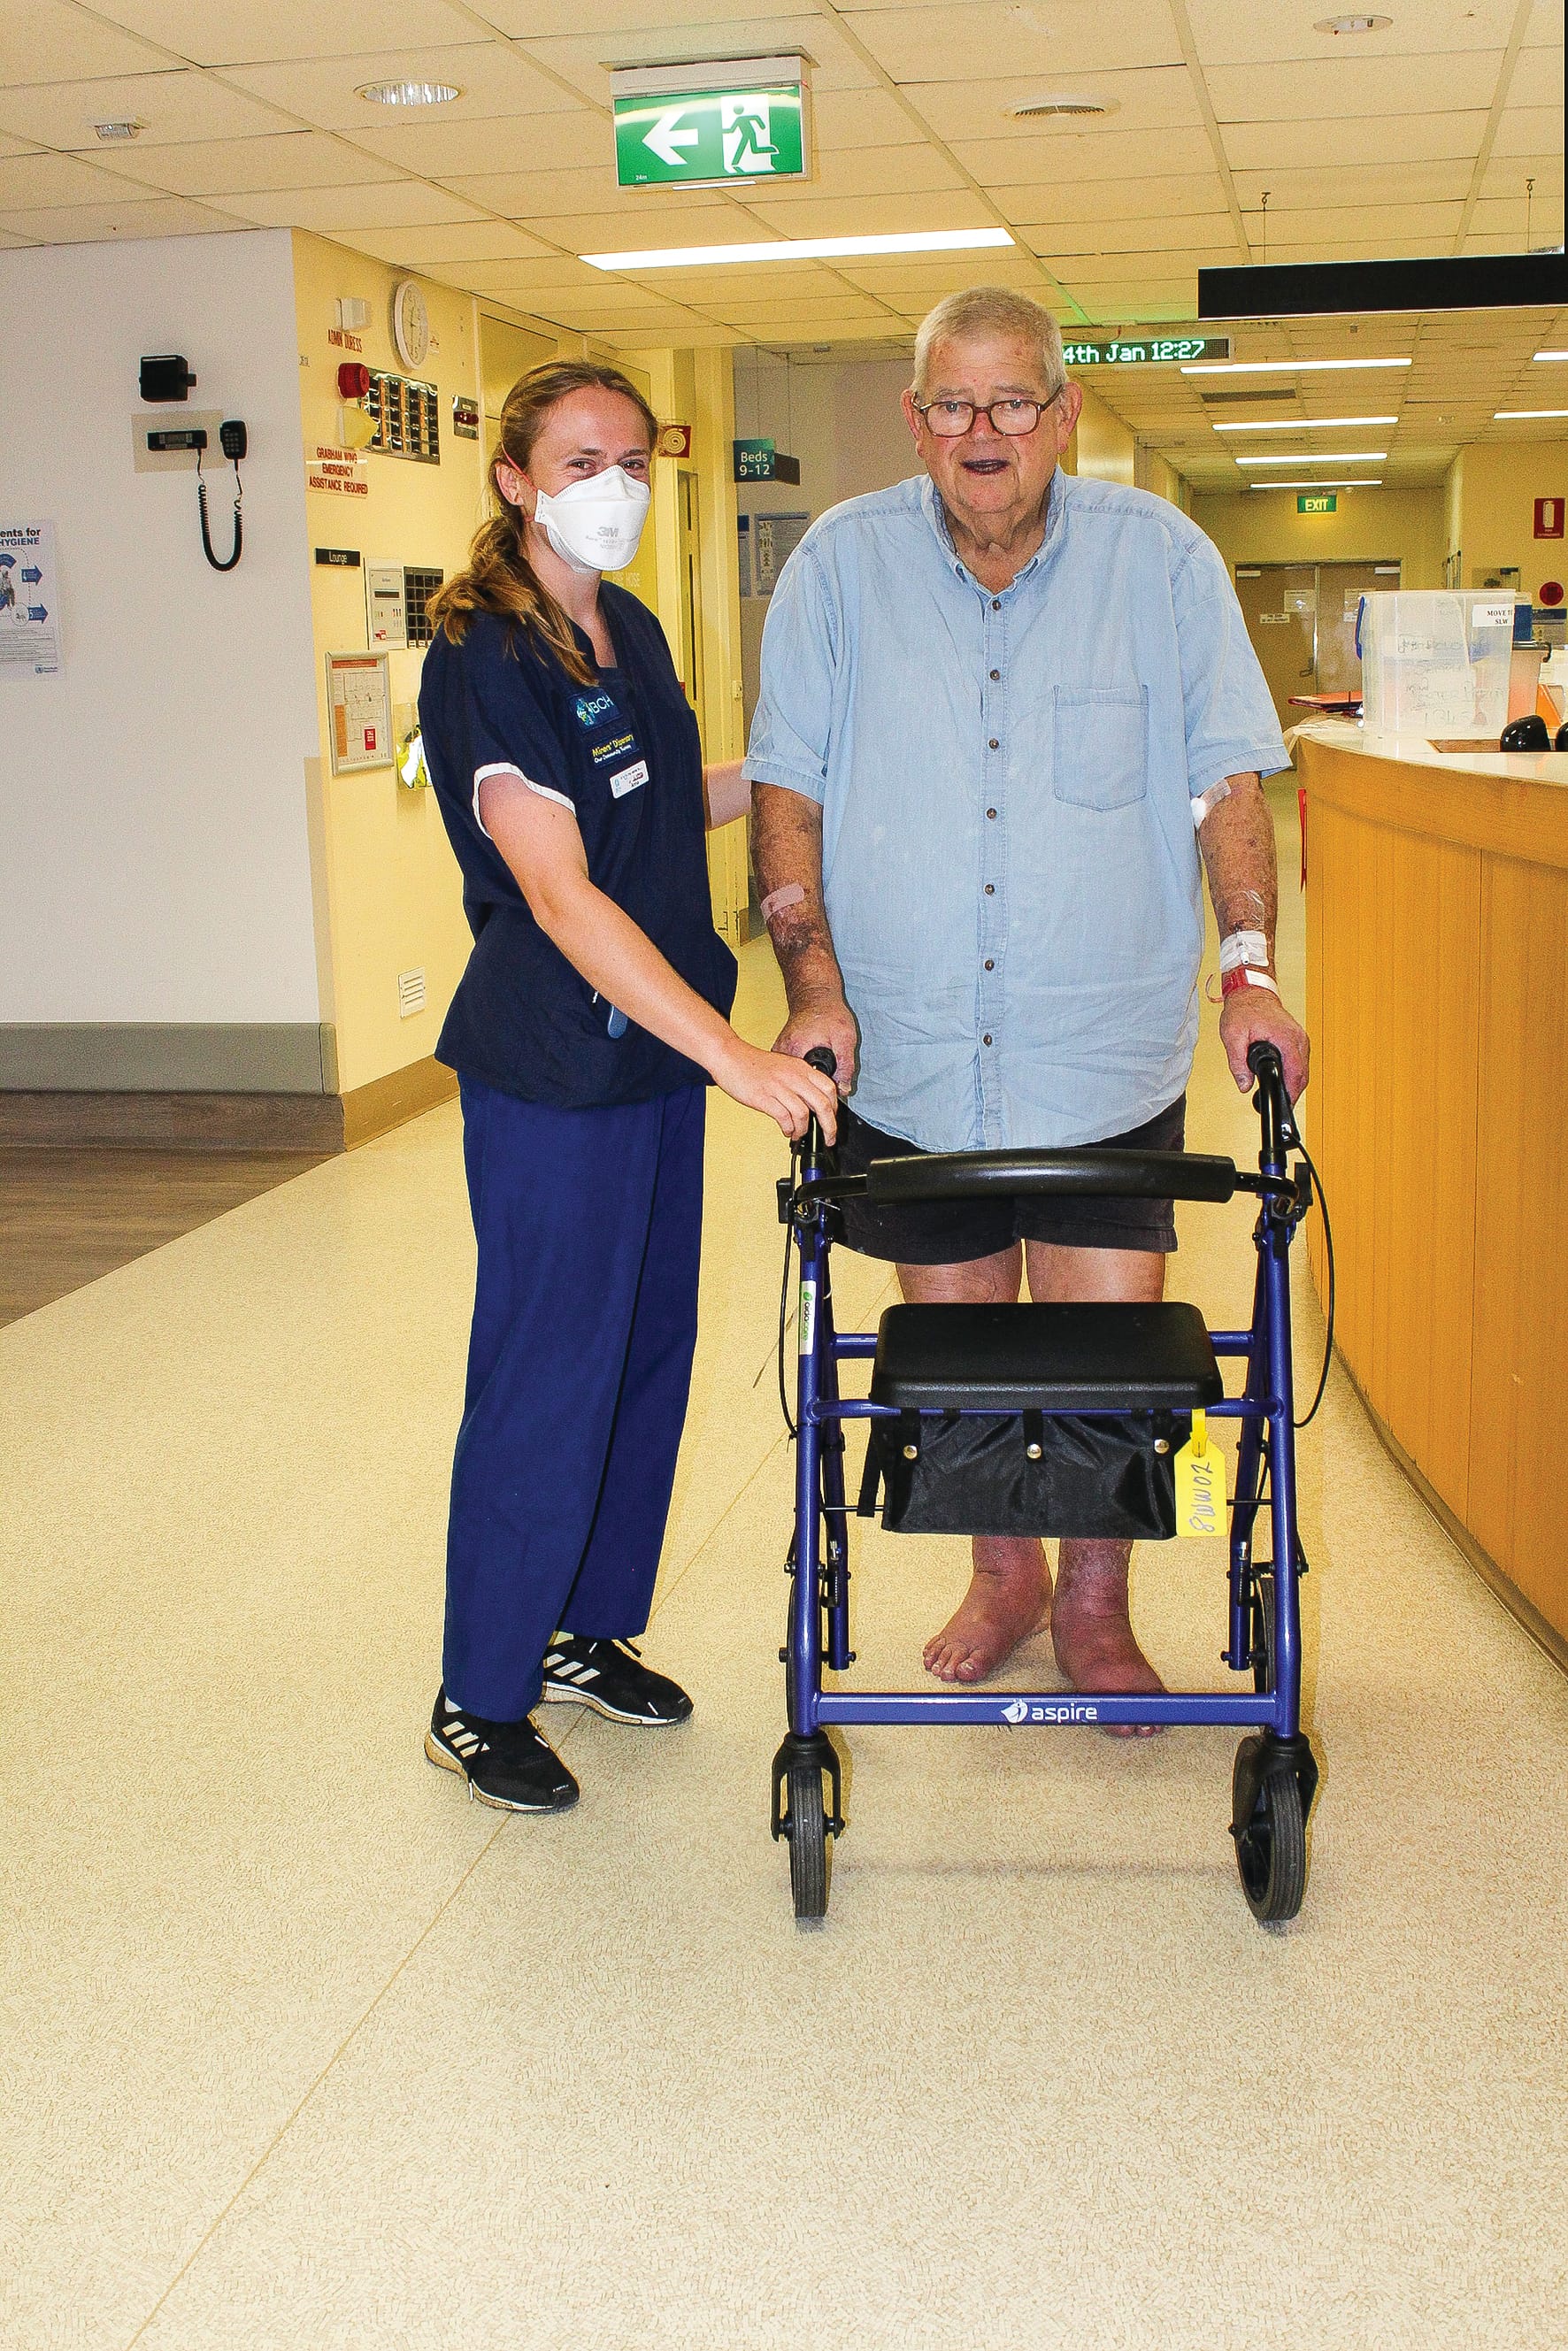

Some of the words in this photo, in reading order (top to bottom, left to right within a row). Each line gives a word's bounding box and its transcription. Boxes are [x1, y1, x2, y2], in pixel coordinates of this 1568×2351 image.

[1063, 345, 1100, 364] 4th
[1105, 343, 1146, 363] Jan
[1151, 340, 1205, 361] 12:27
[316, 447, 342, 460] GRABHAM
[741, 450, 768, 463] Beds
[322, 463, 354, 478] EMERGENCY
[739, 464, 771, 476] 9-12
[309, 476, 342, 492] ASSISTANCE
[343, 481, 368, 495] REQUIRED
[1305, 498, 1329, 511] EXIT
[26, 527, 42, 537] for
[597, 526, 619, 538] 3M
[0, 536, 41, 547] HYGIENE
[328, 550, 348, 565] Lounge
[28, 609, 34, 619] 5
[588, 695, 615, 714] BCH
[1031, 1702, 1098, 1724] aspire
